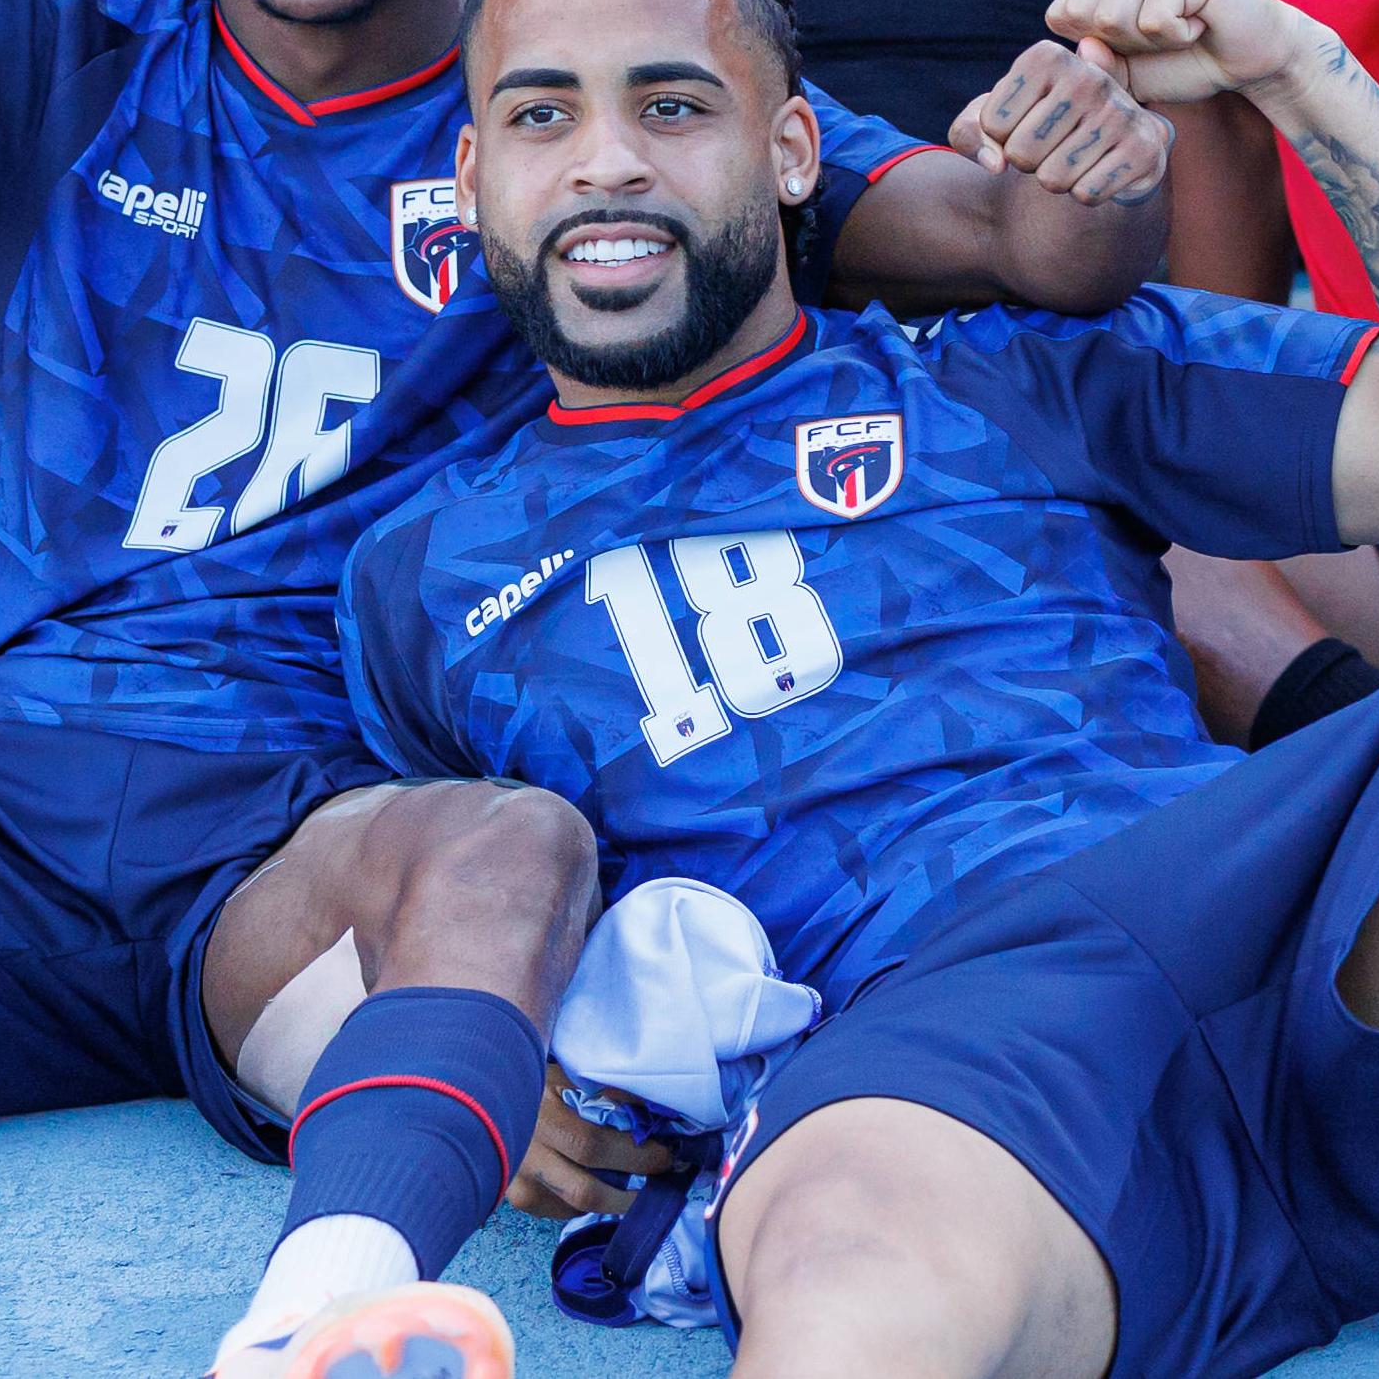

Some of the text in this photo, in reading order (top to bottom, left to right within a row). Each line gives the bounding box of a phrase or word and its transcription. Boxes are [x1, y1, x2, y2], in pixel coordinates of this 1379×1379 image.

[402, 186, 455, 210] FC
[133, 208, 199, 240] SPORT
[122, 316, 381, 554] 26
[807, 420, 892, 443] FCF
[584, 528, 844, 769] 18
